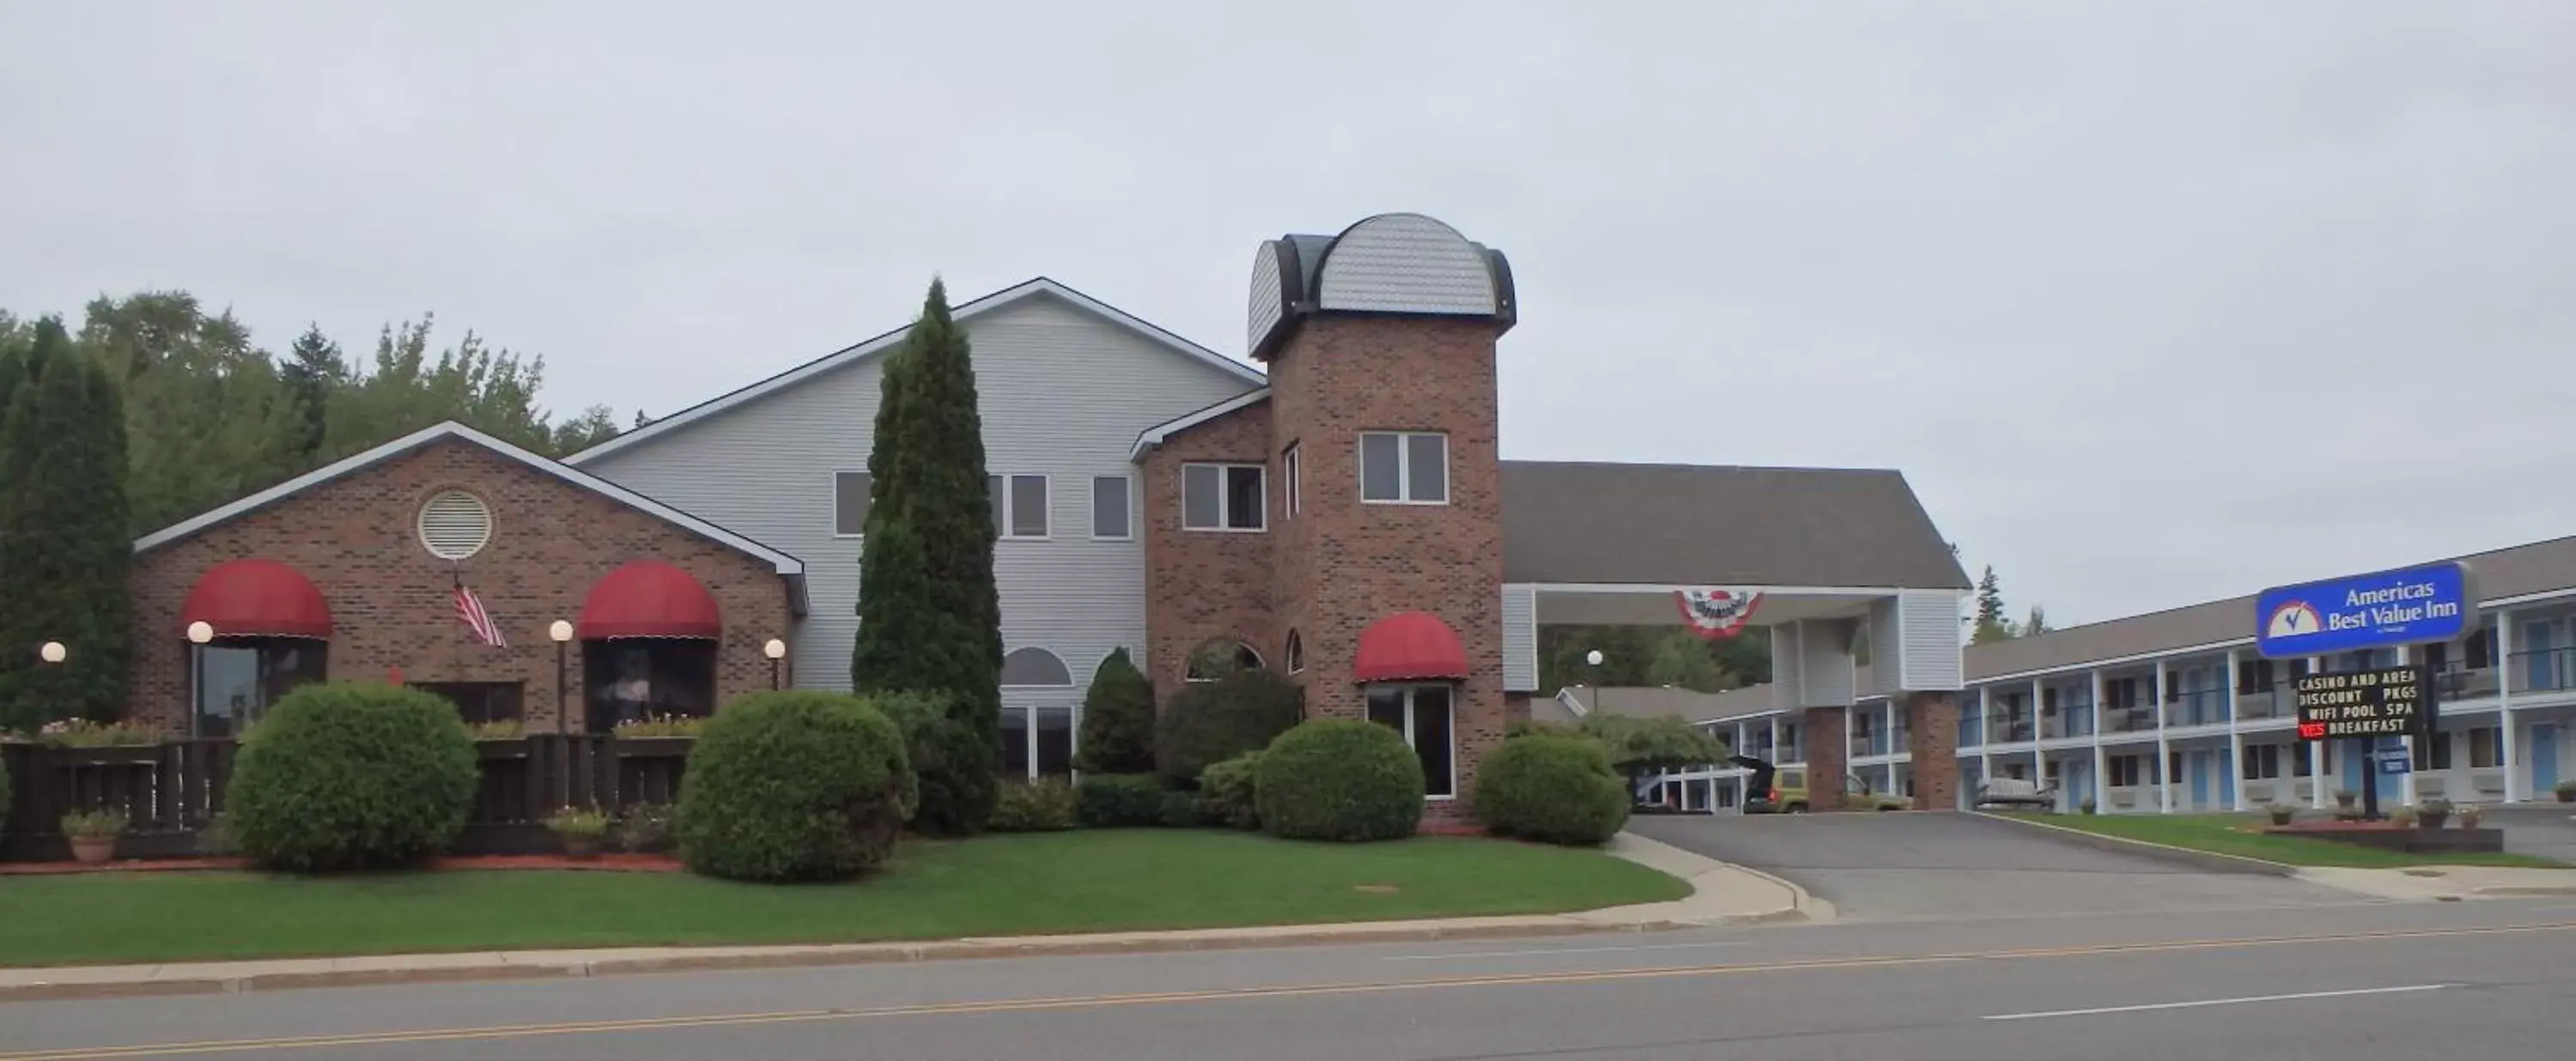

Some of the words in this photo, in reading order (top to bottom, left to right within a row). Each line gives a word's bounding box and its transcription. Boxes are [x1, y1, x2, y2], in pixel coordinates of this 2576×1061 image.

[2345, 581, 2435, 607] Americas
[2329, 610, 2368, 631] Best
[2371, 603, 2423, 625] Value
[2426, 600, 2458, 619] Inn
[2299, 676, 2346, 691] CASINO
[2351, 673, 2378, 687] AND
[2382, 670, 2416, 684] AREA
[2299, 689, 2363, 706] DISCOUNT
[2383, 686, 2418, 701] PKGS
[2308, 706, 2336, 720] WIFI
[2342, 705, 2378, 718] POOL
[2386, 702, 2414, 715] SPA
[2299, 723, 2325, 737] YES
[2329, 718, 2405, 735] BREAKFAST
